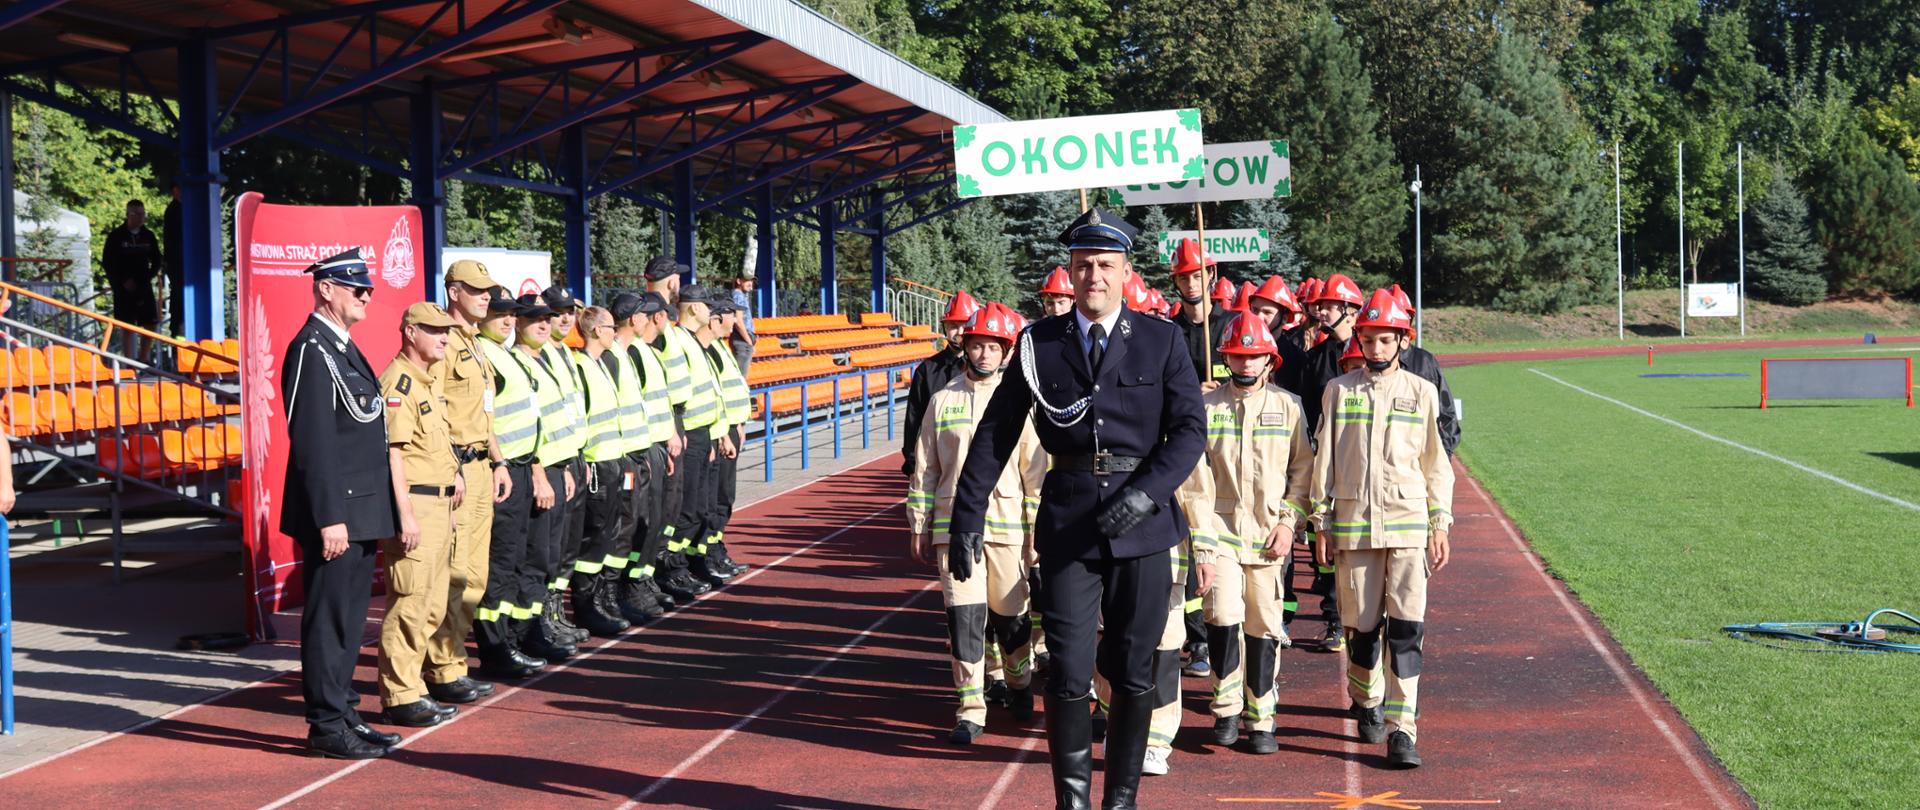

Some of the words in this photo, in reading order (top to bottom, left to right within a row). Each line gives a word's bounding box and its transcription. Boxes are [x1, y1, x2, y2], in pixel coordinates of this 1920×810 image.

[981, 126, 1180, 177] OKONEK
[286, 243, 318, 260] STRAŻ
[1165, 236, 1261, 255] KJENKA
